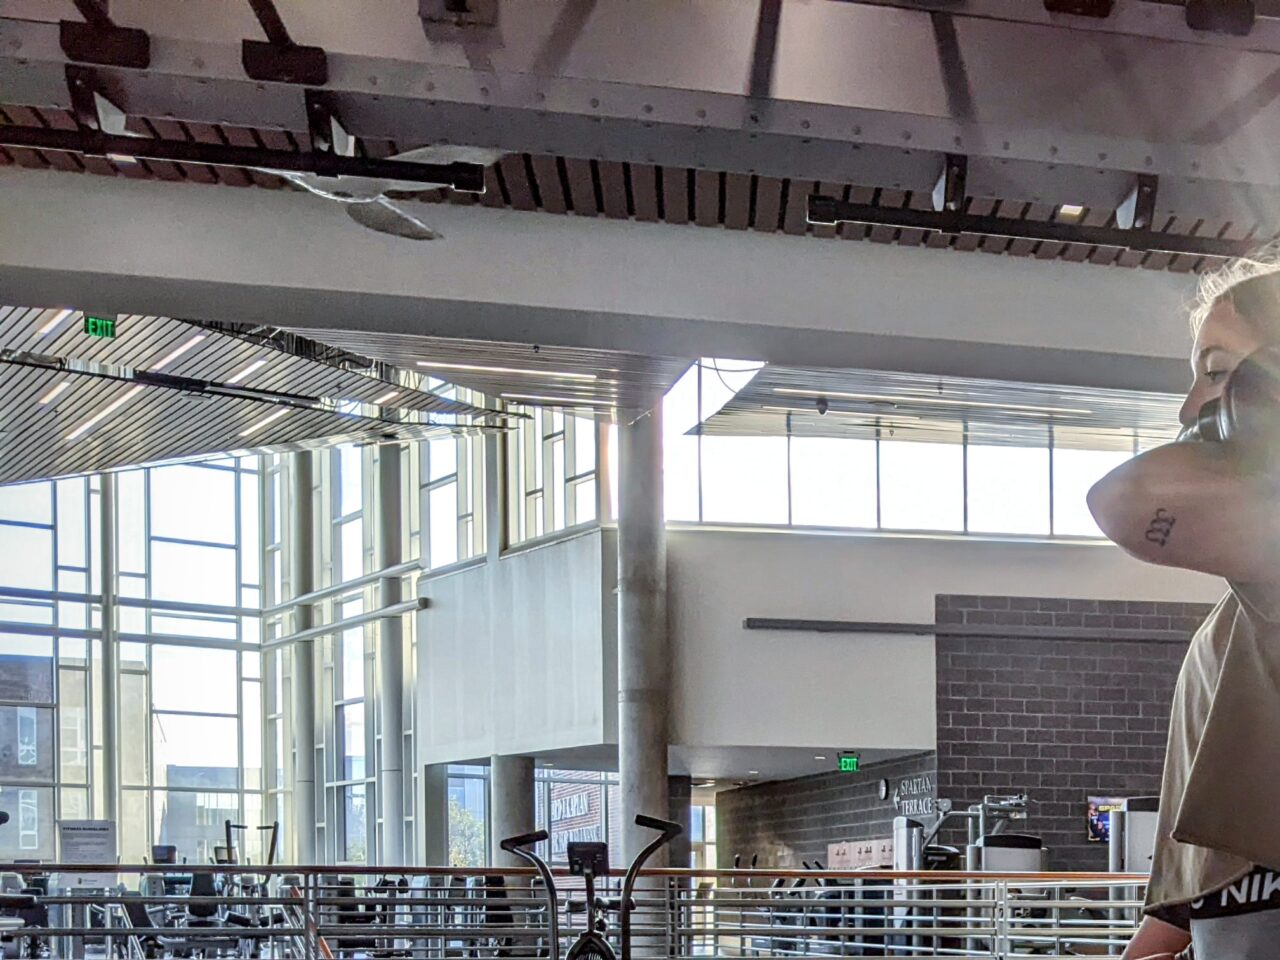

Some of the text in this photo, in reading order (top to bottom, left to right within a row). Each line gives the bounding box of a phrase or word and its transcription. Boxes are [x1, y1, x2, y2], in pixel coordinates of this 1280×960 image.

[89, 317, 114, 337] EXIT
[841, 758, 857, 771] EXIT
[901, 777, 932, 796] SPARTAN
[901, 797, 933, 816] TERRACE
